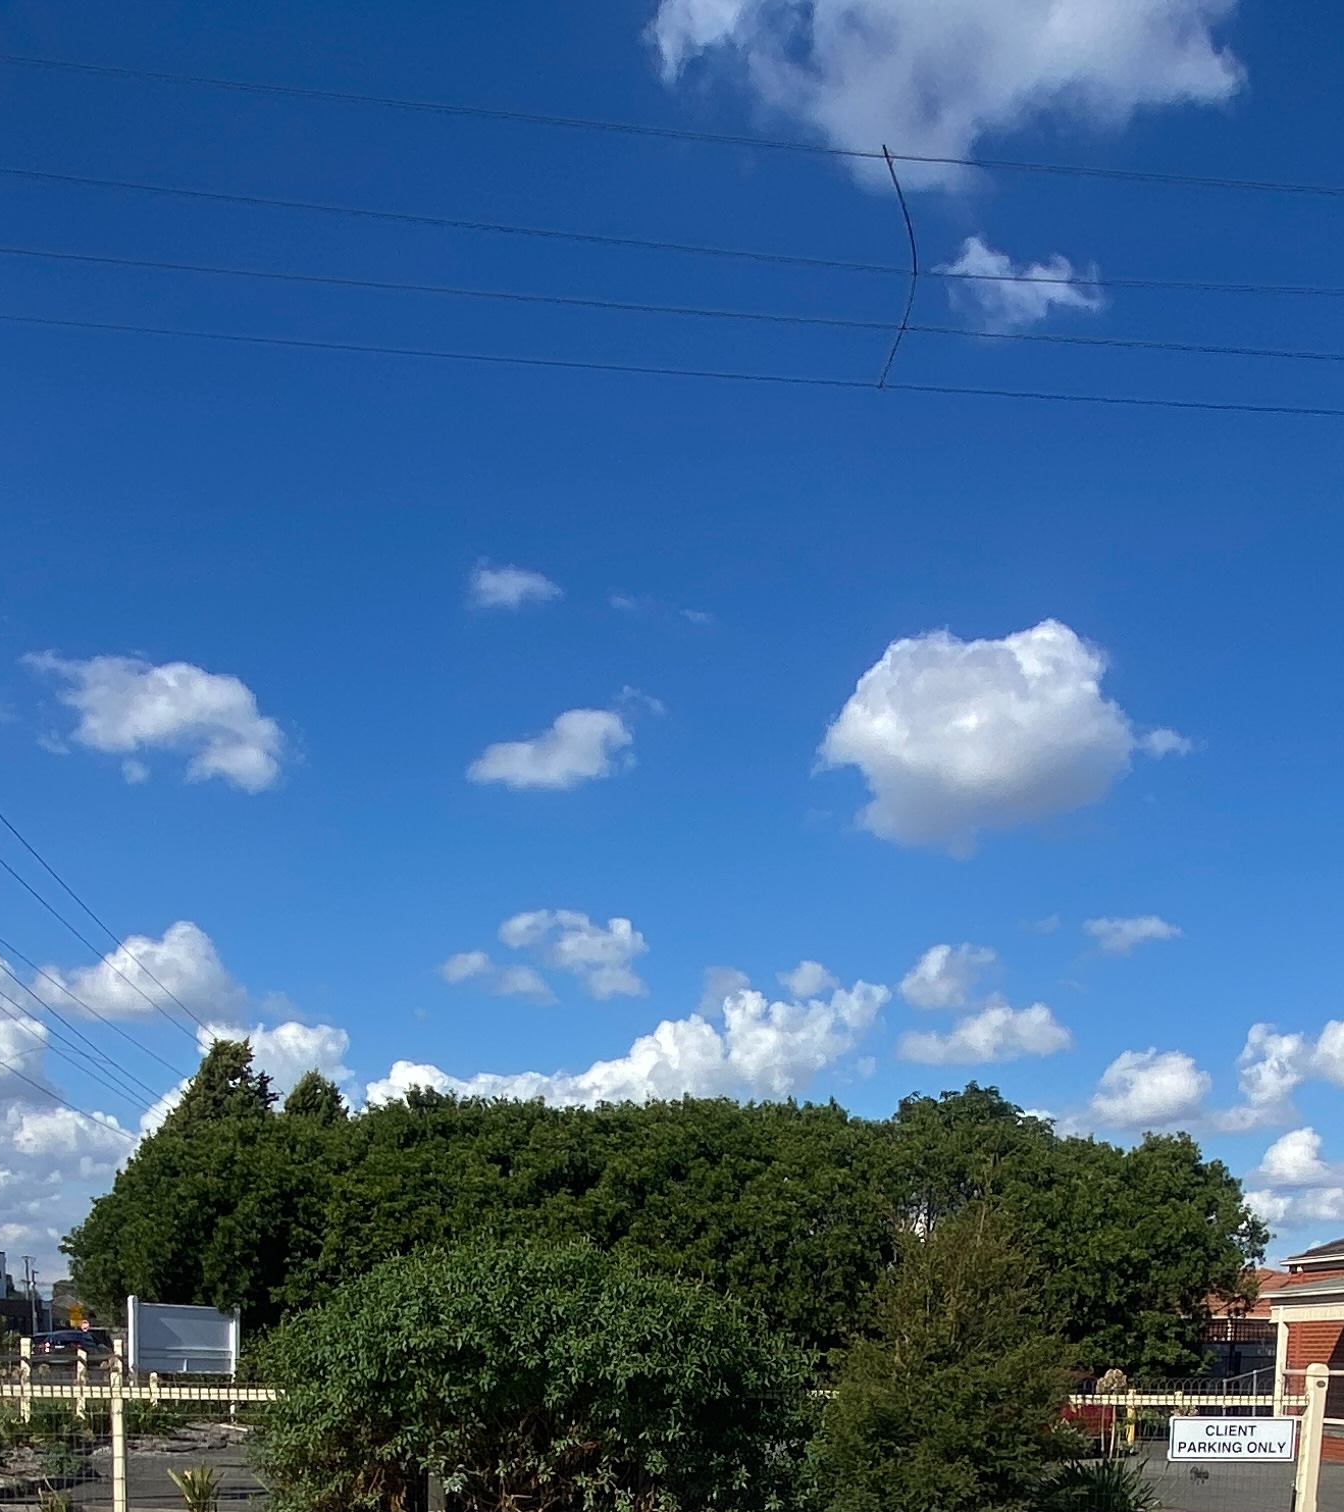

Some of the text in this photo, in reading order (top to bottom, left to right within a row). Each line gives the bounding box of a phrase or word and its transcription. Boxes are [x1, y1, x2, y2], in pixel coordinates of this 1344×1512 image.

[1205, 1425, 1257, 1436] CLIENT
[1178, 1441, 1286, 1453] PARKING ONLY
